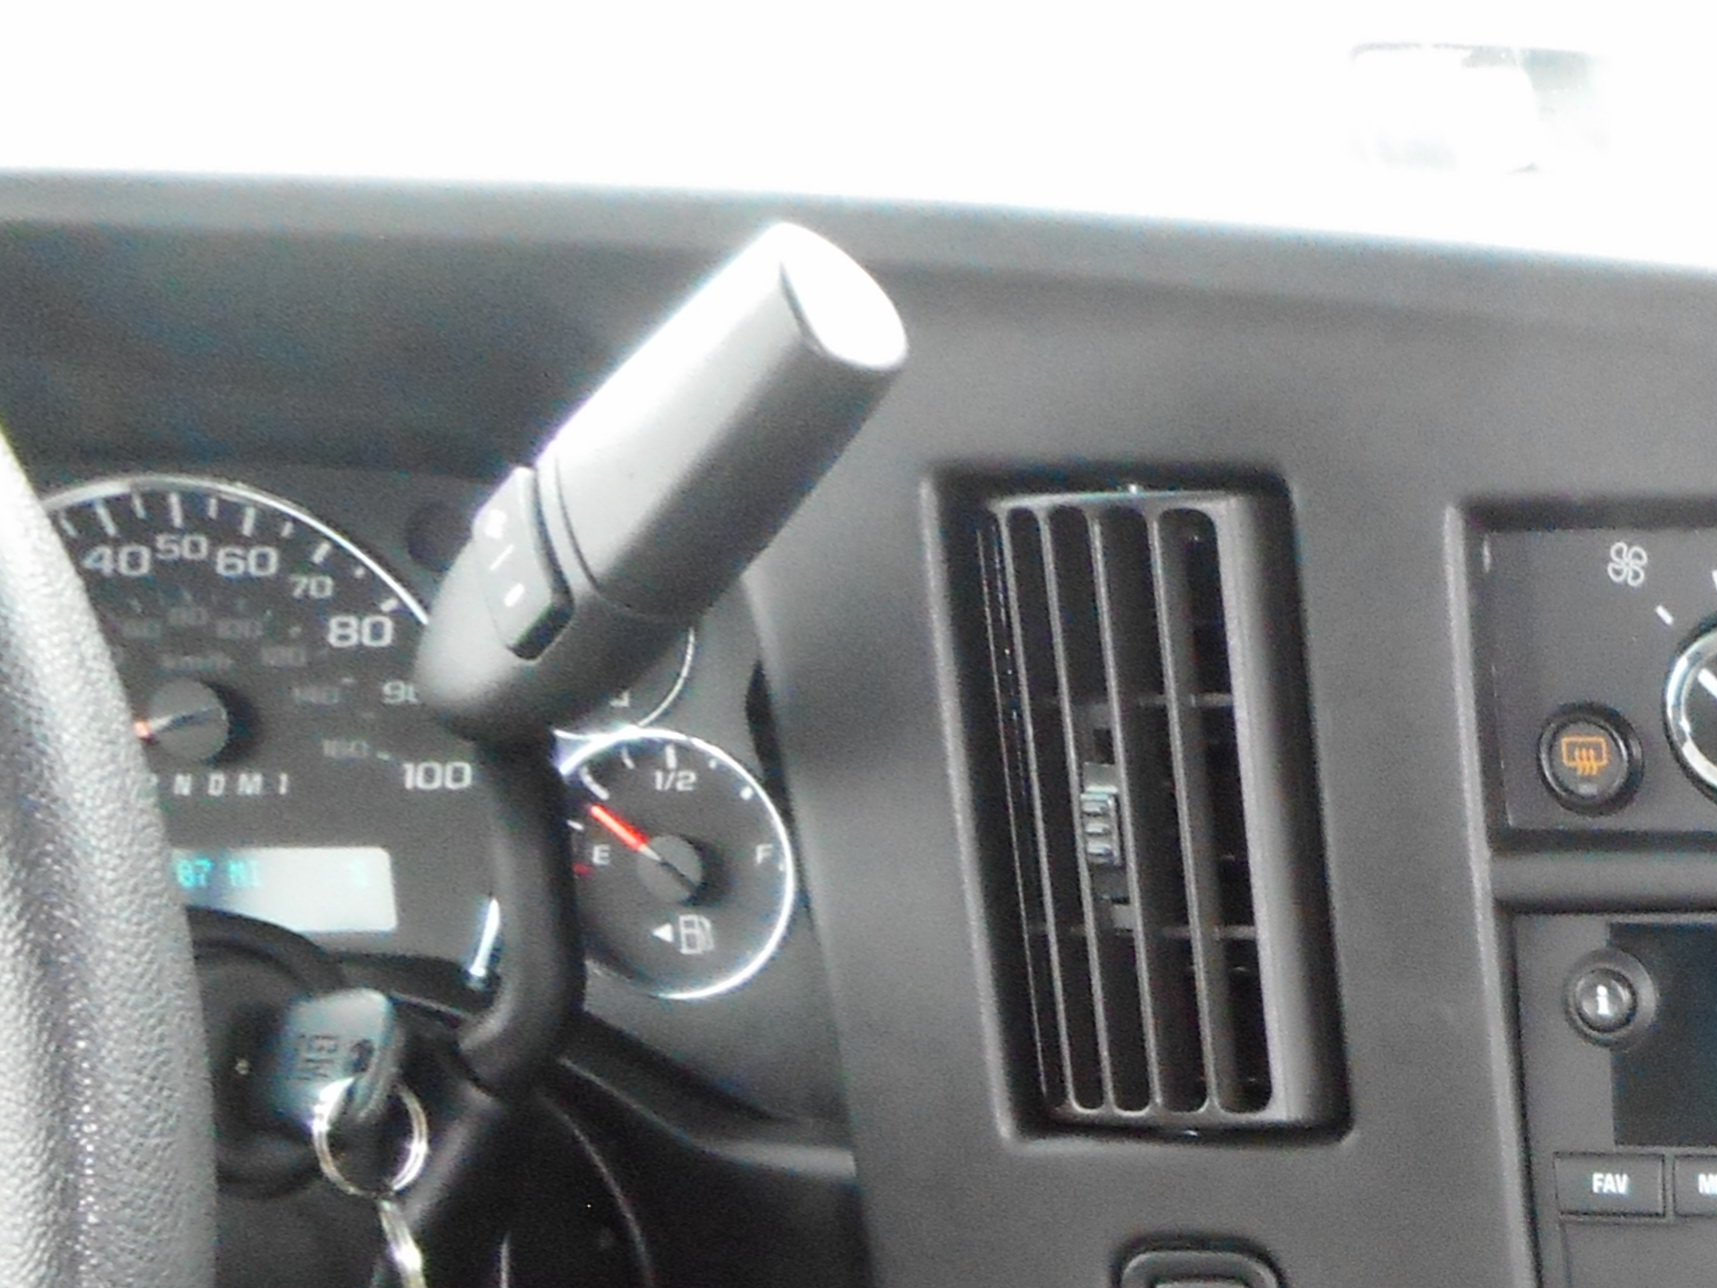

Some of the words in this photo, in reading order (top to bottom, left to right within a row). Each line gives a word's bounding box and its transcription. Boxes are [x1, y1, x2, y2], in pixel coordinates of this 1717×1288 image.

[84, 545, 152, 578] 40
[157, 534, 209, 562] 50
[216, 545, 279, 578] 60
[289, 575, 334, 600] 70
[328, 615, 394, 649] 80
[403, 762, 472, 791] 100
[655, 772, 696, 791] 1/2
[593, 844, 611, 867] E
[755, 843, 773, 866] F
[1592, 1173, 1628, 1195] FAV
